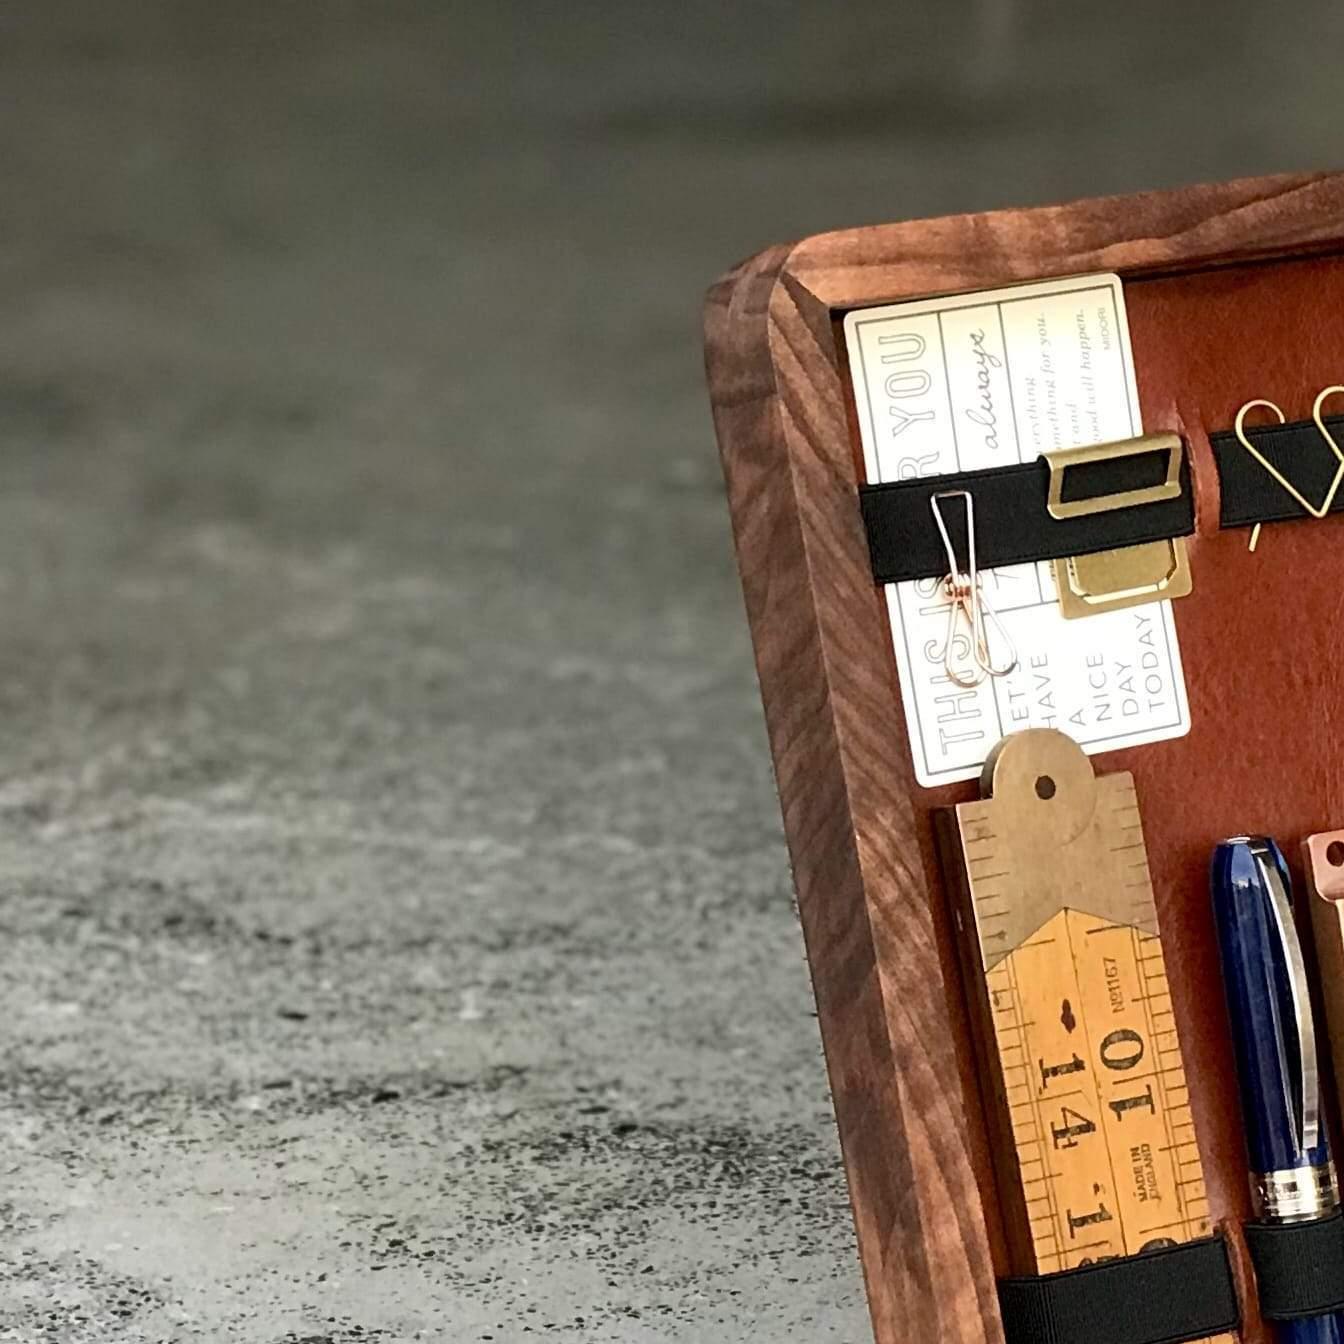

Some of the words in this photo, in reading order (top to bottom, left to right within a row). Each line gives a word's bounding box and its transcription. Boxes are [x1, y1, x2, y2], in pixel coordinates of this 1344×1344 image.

[1036, 312, 1052, 346] you.
[1075, 308, 1093, 371] happen.
[1097, 307, 1112, 351] MIDORI
[878, 331, 937, 442] YOU
[964, 328, 1002, 450] always
[1039, 351, 1056, 375] for
[1081, 375, 1097, 405] will
[1065, 402, 1081, 435] and
[1085, 652, 1113, 722] NICE
[1114, 659, 1140, 717] DAY
[1133, 613, 1166, 714] TODAY
[924, 636, 985, 756] THIS
[1003, 660, 1032, 730] ET'S
[1067, 708, 1087, 726] A
[1038, 1052, 1098, 1151] 14
[1098, 1027, 1157, 1123] 10
[1130, 1145, 1143, 1163] IN
[1133, 1164, 1149, 1203] MADE
